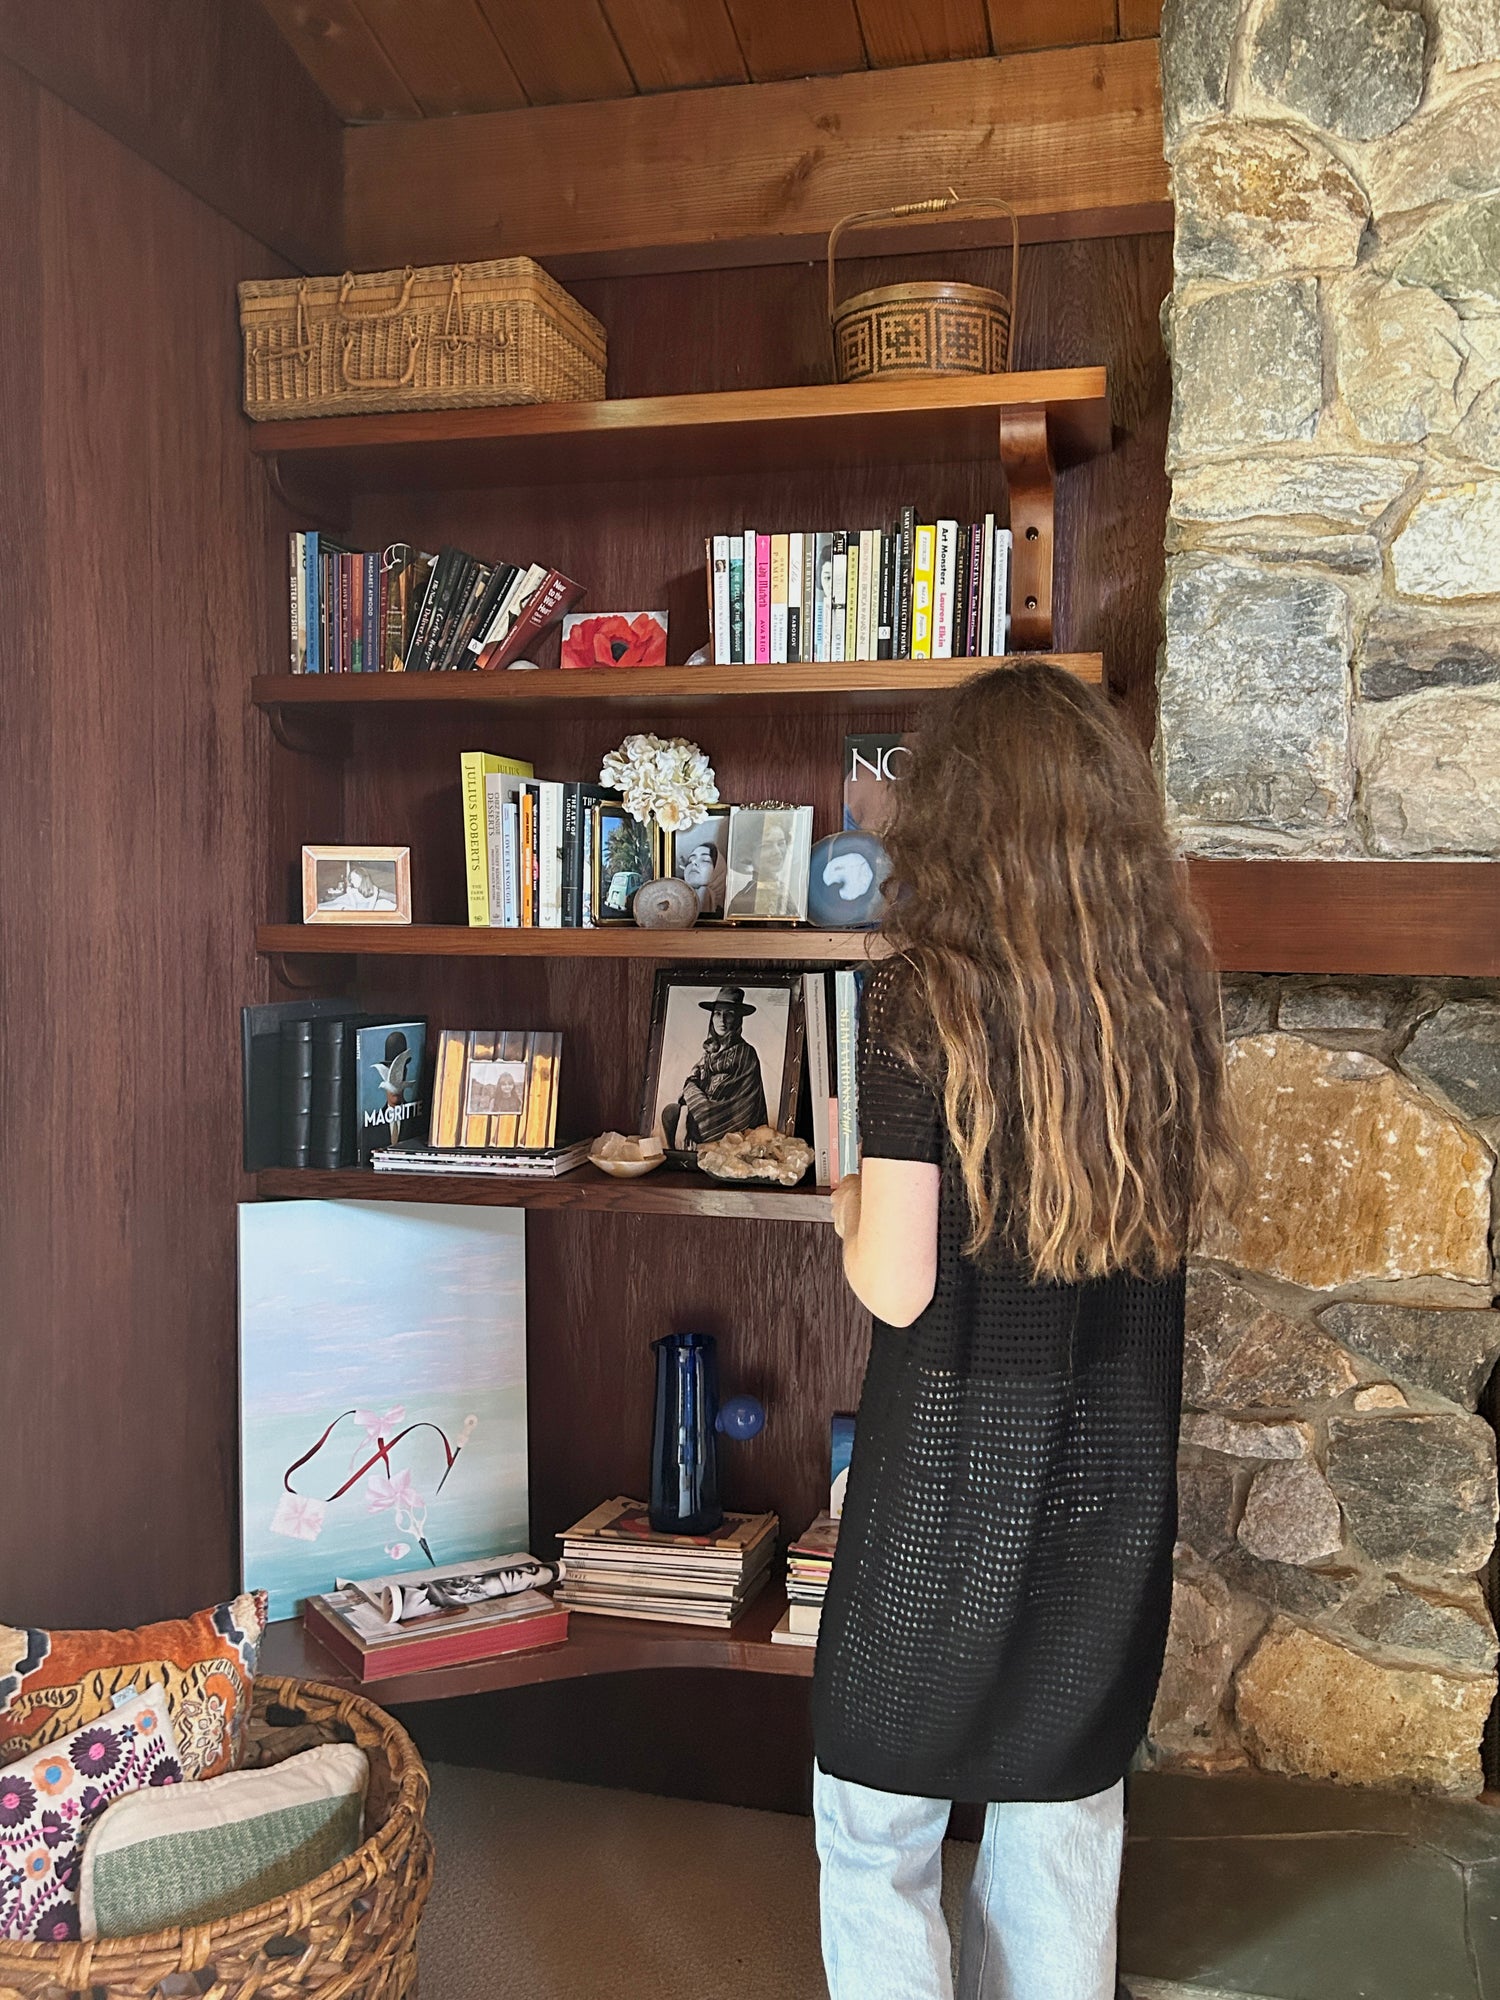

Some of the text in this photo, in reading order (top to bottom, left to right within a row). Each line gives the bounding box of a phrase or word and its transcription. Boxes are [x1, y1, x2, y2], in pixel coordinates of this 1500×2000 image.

[758, 562, 768, 578] Lady
[940, 544, 948, 585] Monsters
[309, 595, 315, 604] OF
[543, 595, 557, 607] Wild
[548, 588, 556, 597] to
[758, 580, 768, 608] Macbeth
[734, 602, 741, 610] OF
[417, 607, 432, 634] Deliver
[414, 634, 424, 646] Me
[938, 625, 946, 648] Elkin
[465, 766, 481, 871] JULIUS ROBERTS
[487, 793, 495, 837] DESSERTS
[570, 827, 576, 836] OF
[505, 858, 511, 868] IS
[840, 1008, 853, 1136] SLIM AARONS Style
[364, 1100, 422, 1128] MAGRITTE
